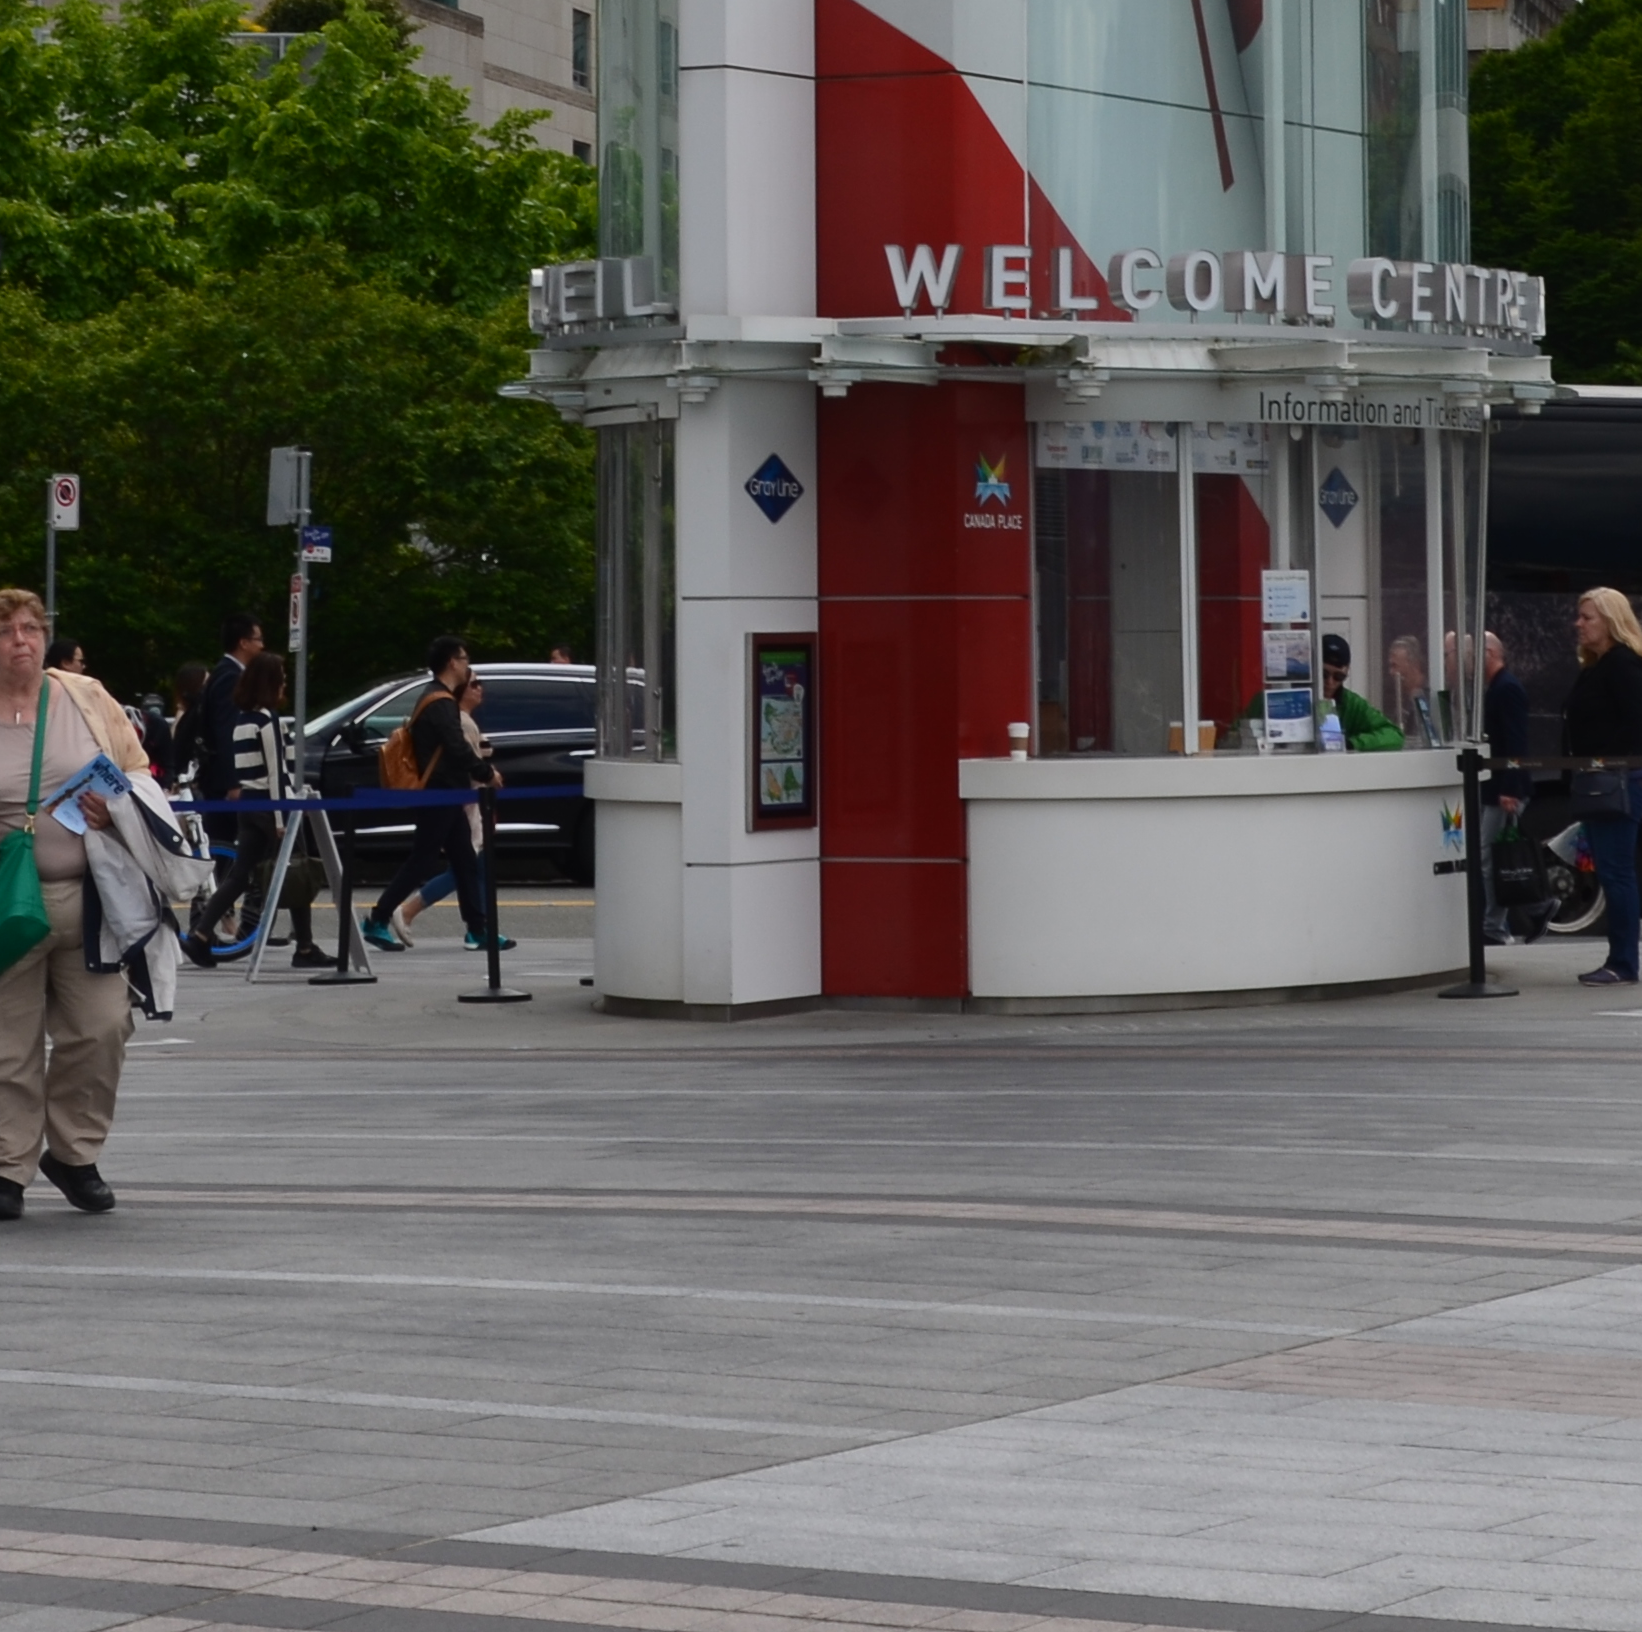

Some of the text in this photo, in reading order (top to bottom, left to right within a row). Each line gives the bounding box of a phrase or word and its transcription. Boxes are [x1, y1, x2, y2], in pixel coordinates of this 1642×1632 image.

[884, 244, 1528, 329] WELCOME CENTRE
[1259, 391, 1387, 424] Information
[1393, 398, 1422, 426] and
[964, 513, 1023, 530] CANADA PLACE
[92, 760, 125, 795] where
